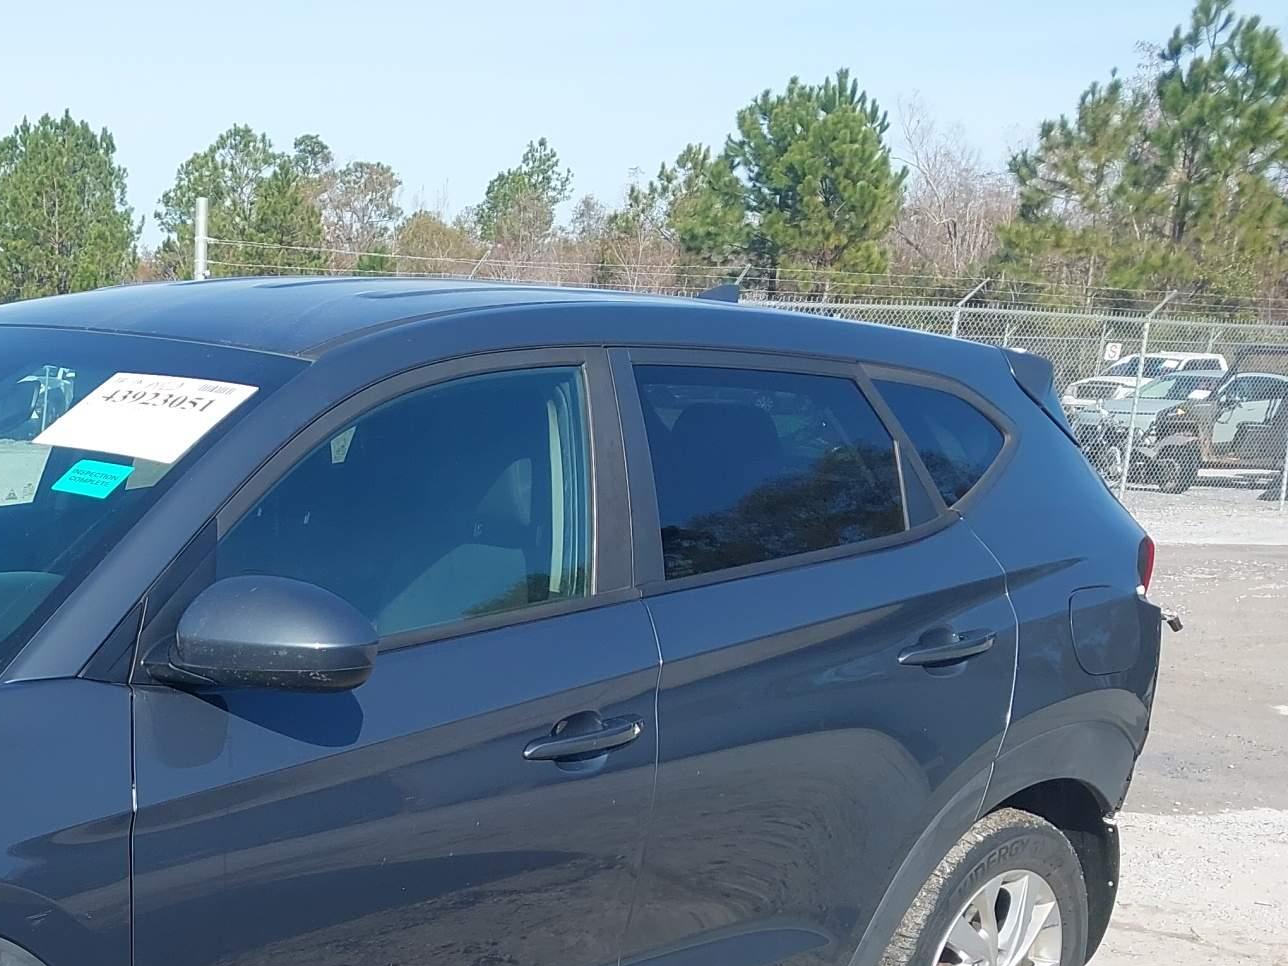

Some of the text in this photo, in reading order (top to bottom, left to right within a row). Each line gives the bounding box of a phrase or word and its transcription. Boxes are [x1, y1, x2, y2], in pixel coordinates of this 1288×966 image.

[102, 389, 216, 412] 43923051
[72, 468, 119, 481] INSPECTION
[68, 475, 112, 488] COMPLETE
